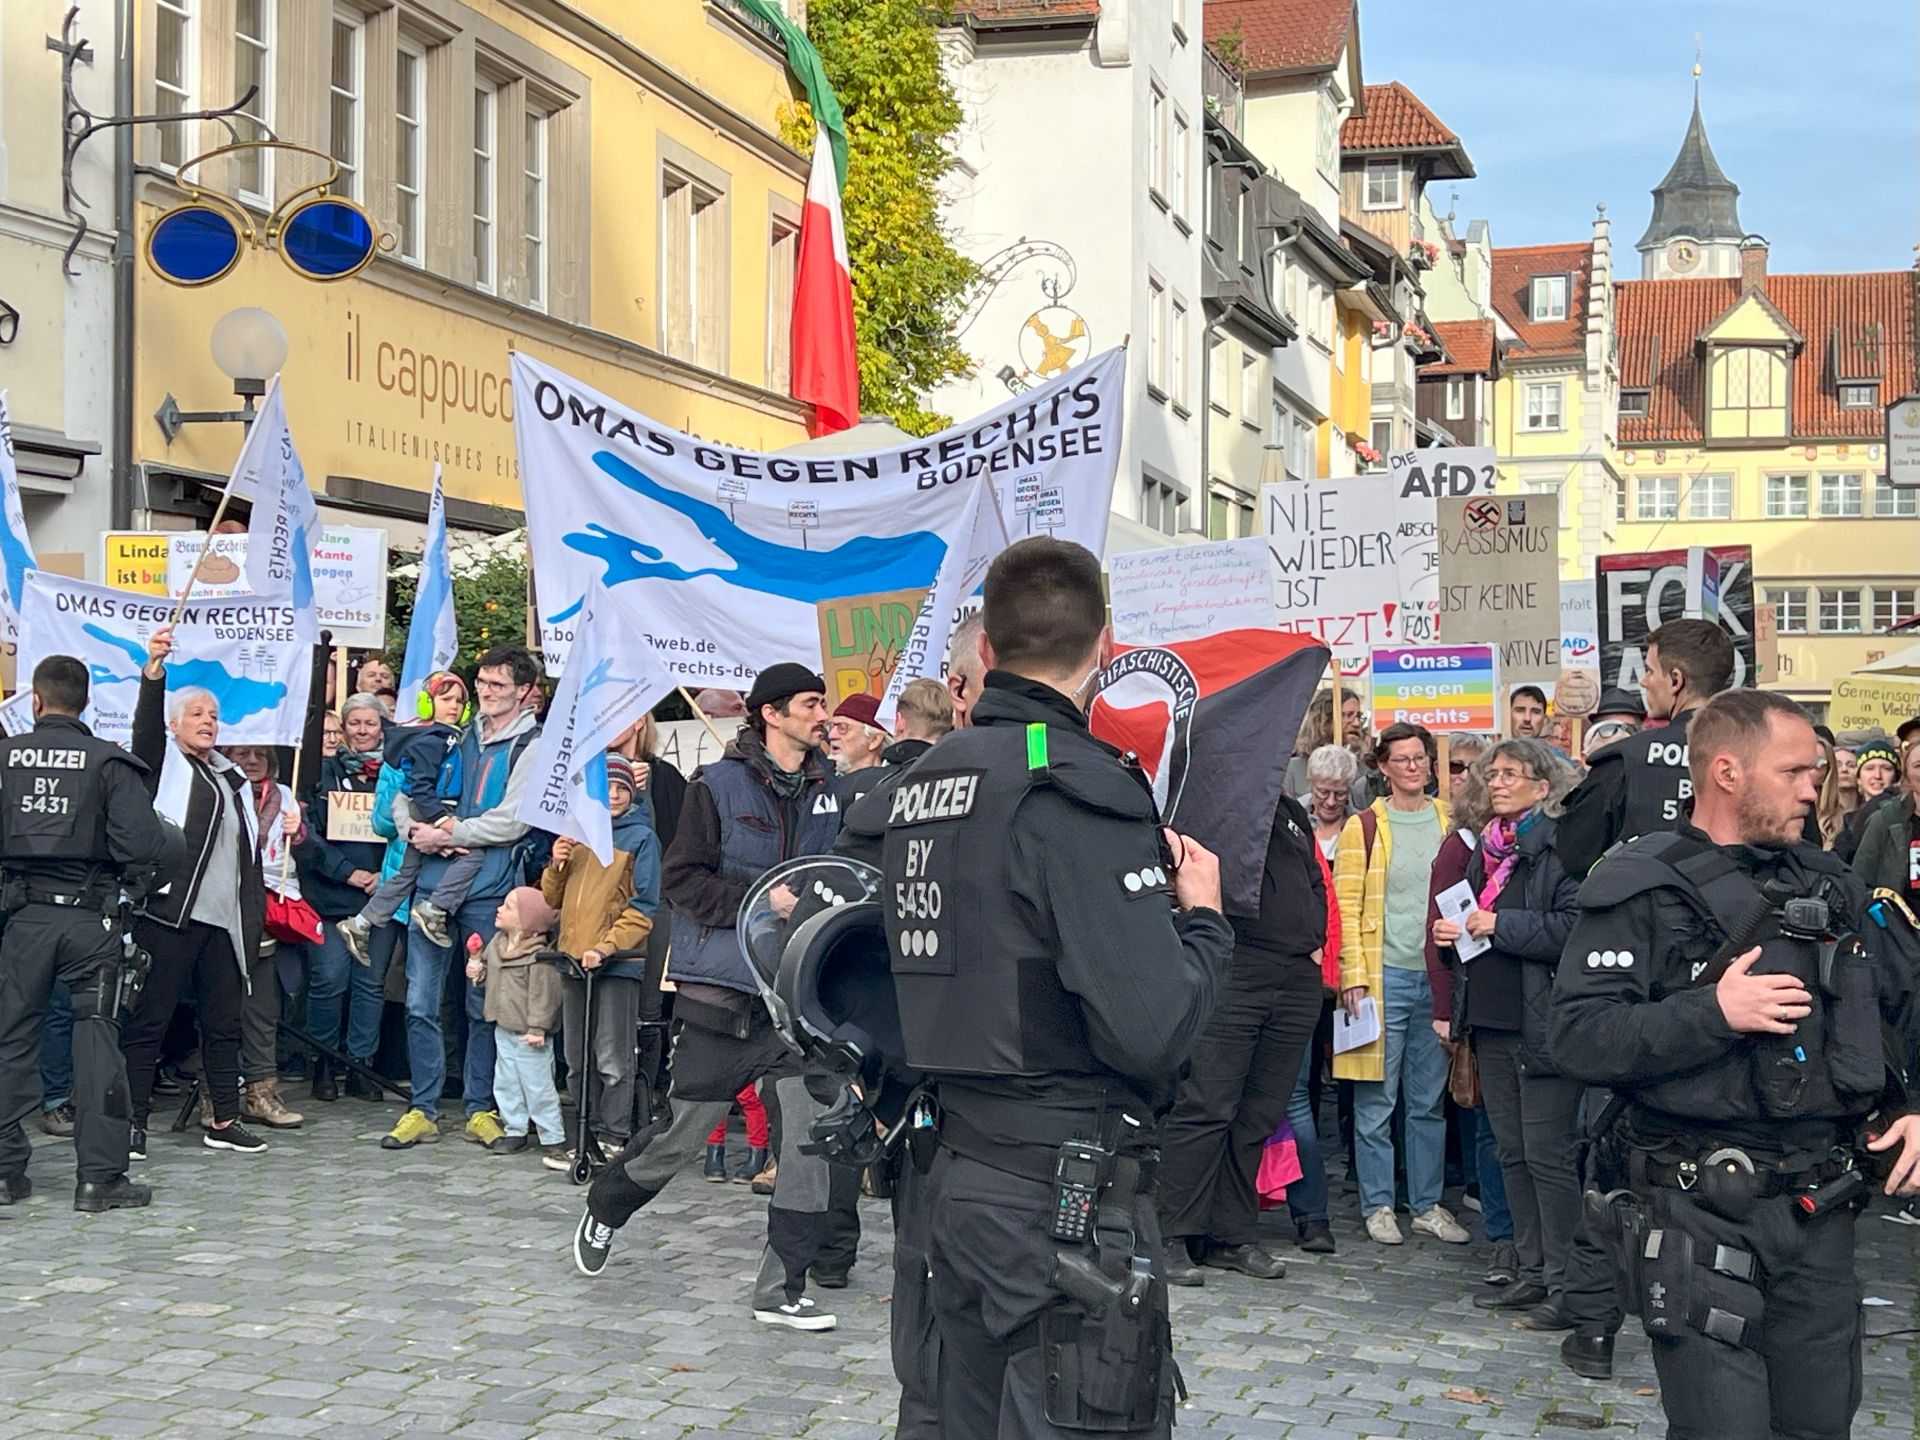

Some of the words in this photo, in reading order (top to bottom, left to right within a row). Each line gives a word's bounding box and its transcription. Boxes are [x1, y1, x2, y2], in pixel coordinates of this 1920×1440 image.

[348, 311, 360, 382] il
[534, 380, 676, 456] OMAS
[692, 446, 879, 484] GEGEN
[900, 376, 1100, 473] RECHTS
[347, 420, 482, 472] ITALIENISCHES
[497, 455, 519, 479] EIS
[917, 424, 1103, 490] BODENSEE
[1390, 451, 1418, 470] DIE
[1440, 525, 1551, 555] RASSISMUS
[314, 549, 353, 561] Kante
[118, 570, 137, 584] ist
[313, 567, 353, 579] gegen
[1479, 582, 1538, 611] KEINE
[56, 592, 116, 618] OMAS
[122, 603, 201, 625] GEGEN
[205, 607, 295, 626] RECHTS
[214, 627, 295, 642] BODENSEE
[826, 600, 926, 659] LIND
[1561, 637, 1589, 649] AfD
[905, 624, 931, 685] RECH
[1399, 654, 1462, 670] Omas
[663, 660, 762, 679] rechts-de
[1397, 684, 1465, 700] gegen
[1394, 708, 1470, 724] Rechts
[1861, 703, 1872, 712] in
[1841, 715, 1880, 729] gegen
[8, 748, 87, 769] POLIZEI
[34, 777, 60, 795] BY
[20, 795, 69, 814] 5431
[888, 775, 979, 823] POLIZEI
[1662, 799, 1678, 820] 5
[906, 839, 934, 877] BY
[896, 881, 942, 919] 5430
